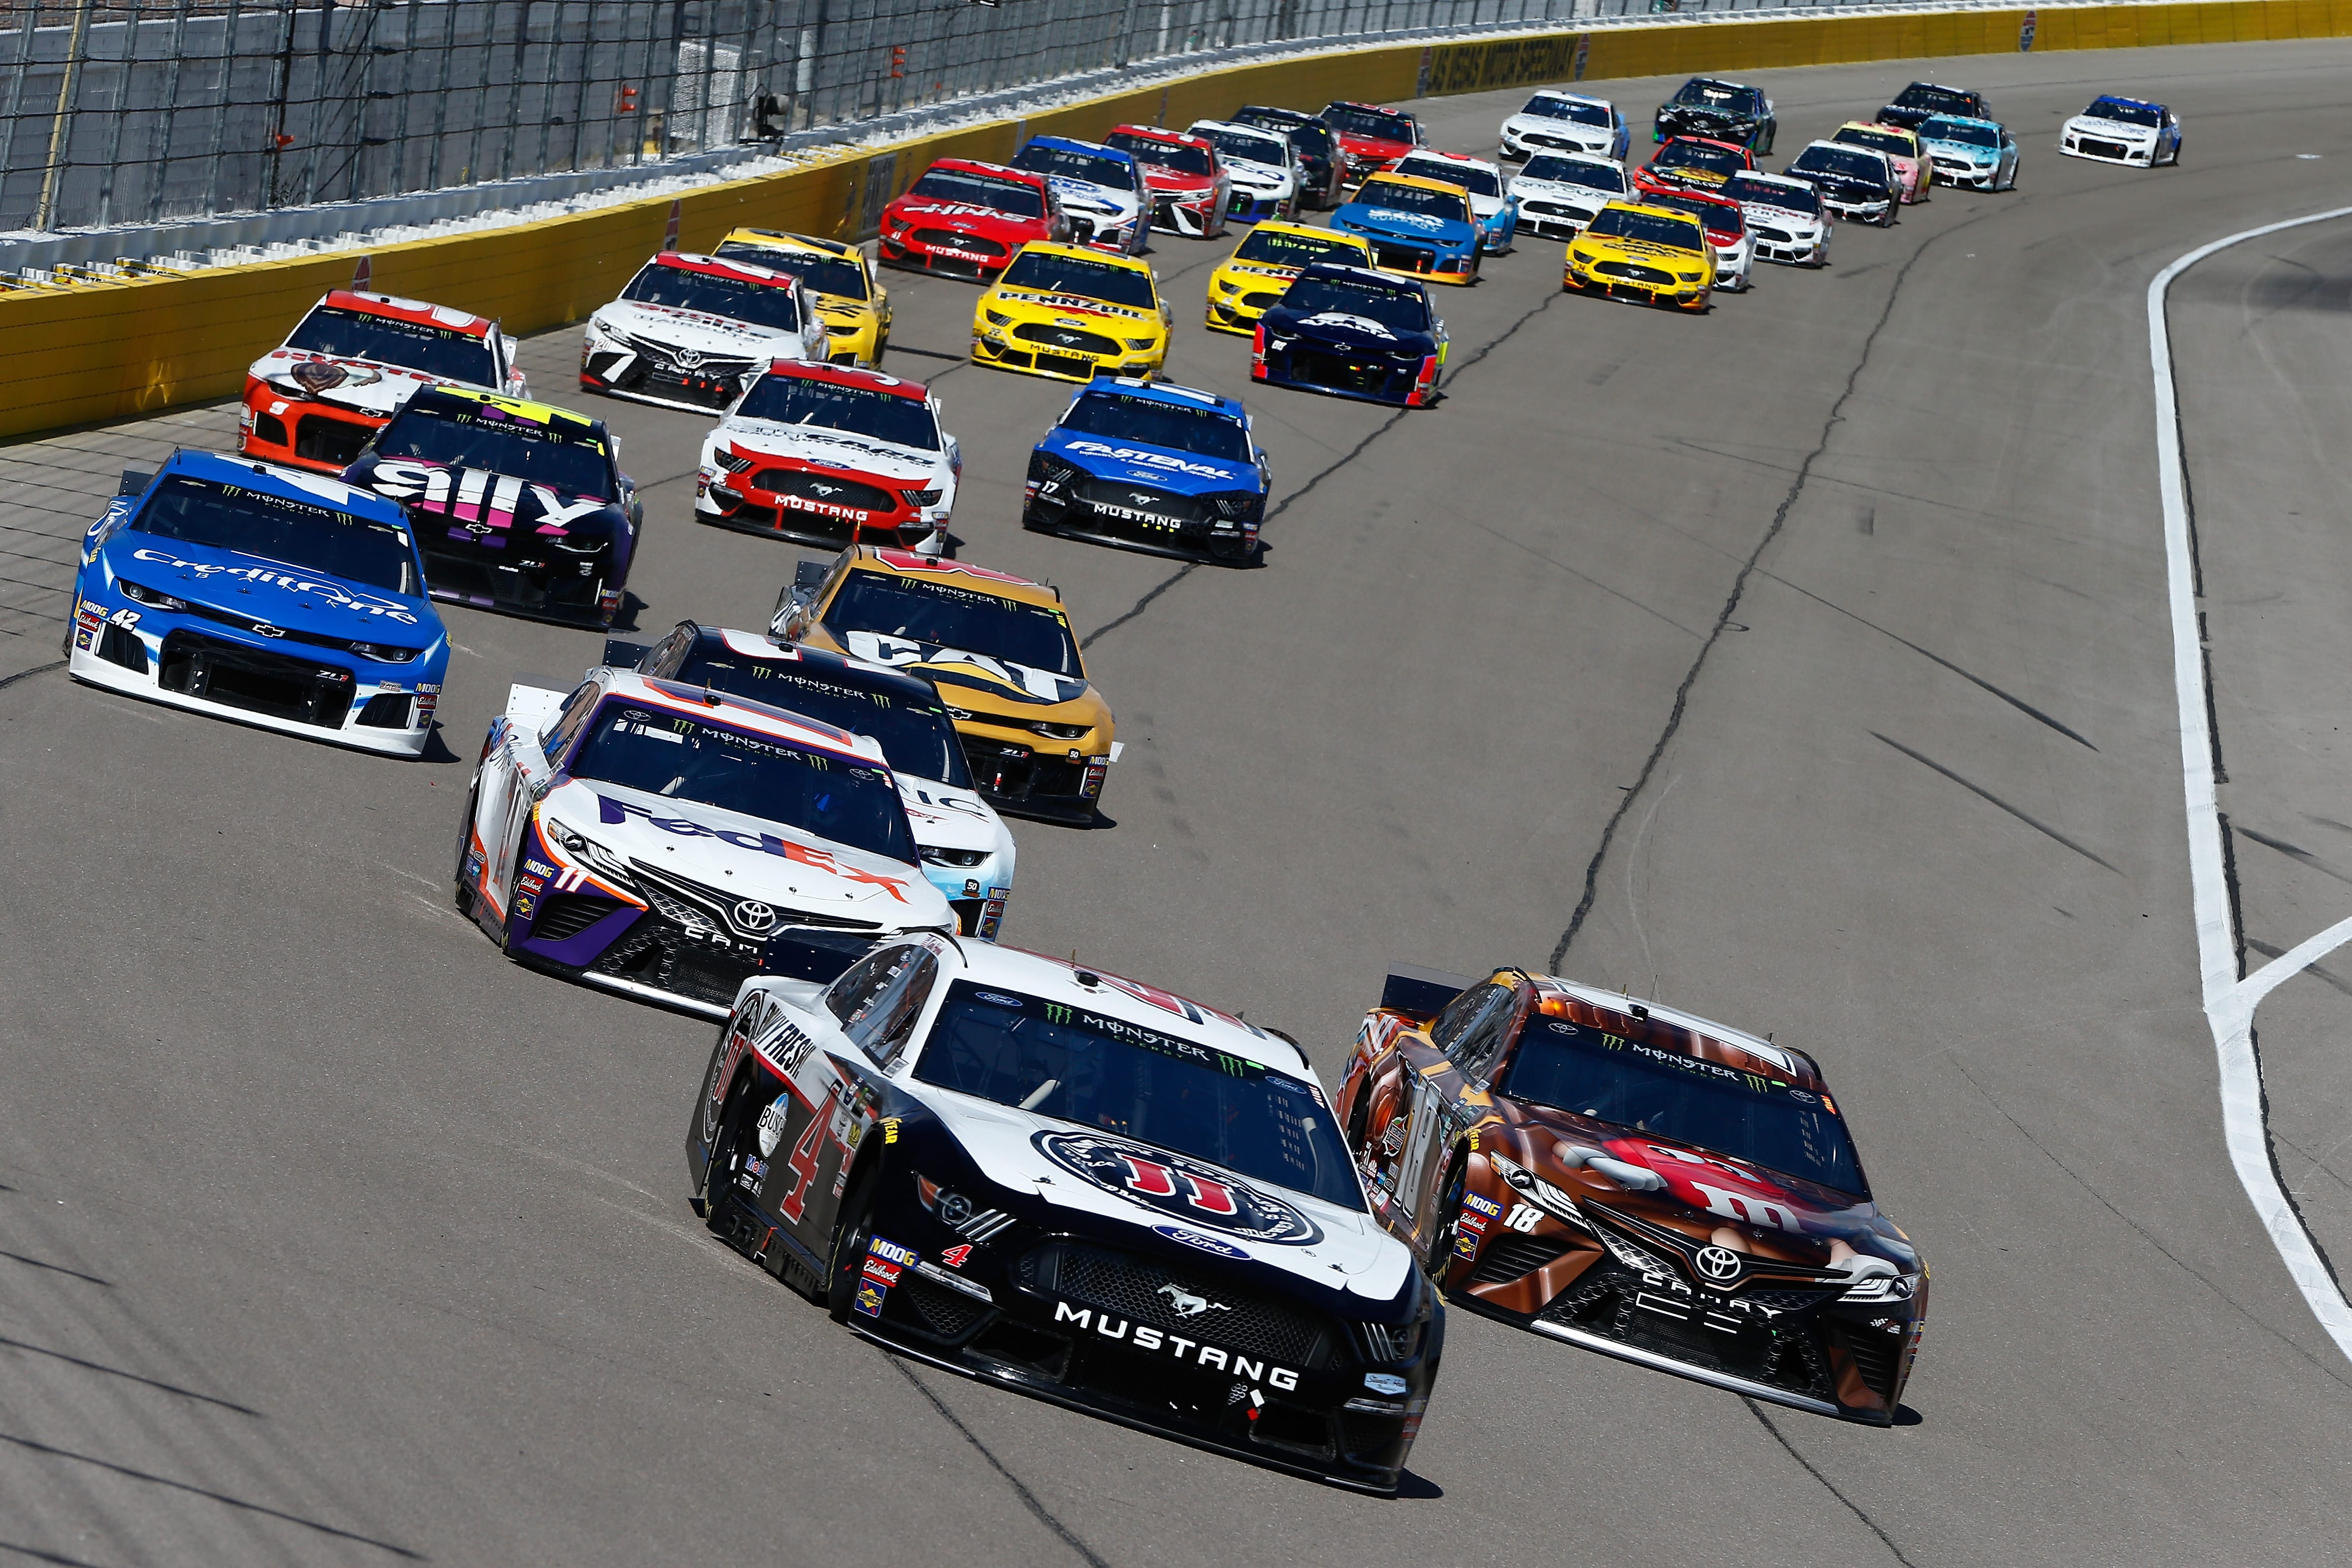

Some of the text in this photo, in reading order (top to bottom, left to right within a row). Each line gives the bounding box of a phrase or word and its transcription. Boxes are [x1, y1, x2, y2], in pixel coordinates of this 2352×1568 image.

[925, 245, 989, 262] MUSTANG
[376, 318, 434, 334] MONSTER
[1297, 318, 1398, 341] AXALTA
[596, 339, 610, 350] 20
[1030, 344, 1099, 362] MUSTANG
[817, 382, 876, 397] MONSTER
[476, 418, 543, 437] MONSTER
[1065, 440, 1233, 480] FASTENAL
[1041, 481, 1059, 493] 17
[247, 492, 330, 517] MONSTER
[775, 496, 868, 521] MUSTANG
[1094, 505, 1182, 529] MUSTANG
[923, 583, 996, 604] MONSTER
[81, 600, 109, 617] MOOG
[111, 608, 143, 632] 42
[316, 670, 349, 681] ZL1
[846, 631, 1076, 702] CAT
[416, 683, 441, 693] MOOG
[779, 673, 866, 699] MONSTER
[701, 727, 801, 760] MONSTER
[725, 742, 780, 759] ENERGY
[1000, 748, 1029, 758] ZL1
[597, 794, 912, 905] FedEx
[524, 859, 555, 877] MOOG
[553, 866, 593, 893] 11
[521, 876, 542, 892] Edelbrock
[967, 882, 977, 890] 50
[989, 889, 1009, 900] MOOG
[685, 927, 758, 954] CAM
[984, 994, 1016, 1005] Ford
[1083, 1014, 1210, 1061] MONSTER
[1114, 1035, 1184, 1059] ENERGY
[1633, 1044, 1739, 1081] MONSTER
[1658, 1061, 1718, 1079] ENERGY
[1274, 1078, 1300, 1093] Ford
[780, 1082, 841, 1225] 4
[1463, 1193, 1499, 1216] MOOG
[1460, 1212, 1486, 1232] Edelbrock
[1503, 1203, 1544, 1233] 18
[869, 1238, 917, 1267] MOOG
[1172, 1230, 1232, 1254] Ford
[942, 1244, 973, 1268] 4
[863, 1260, 898, 1283] Edelbrock
[1642, 1273, 1783, 1318] CAMRY
[1055, 1301, 1299, 1391] MUSTANG
